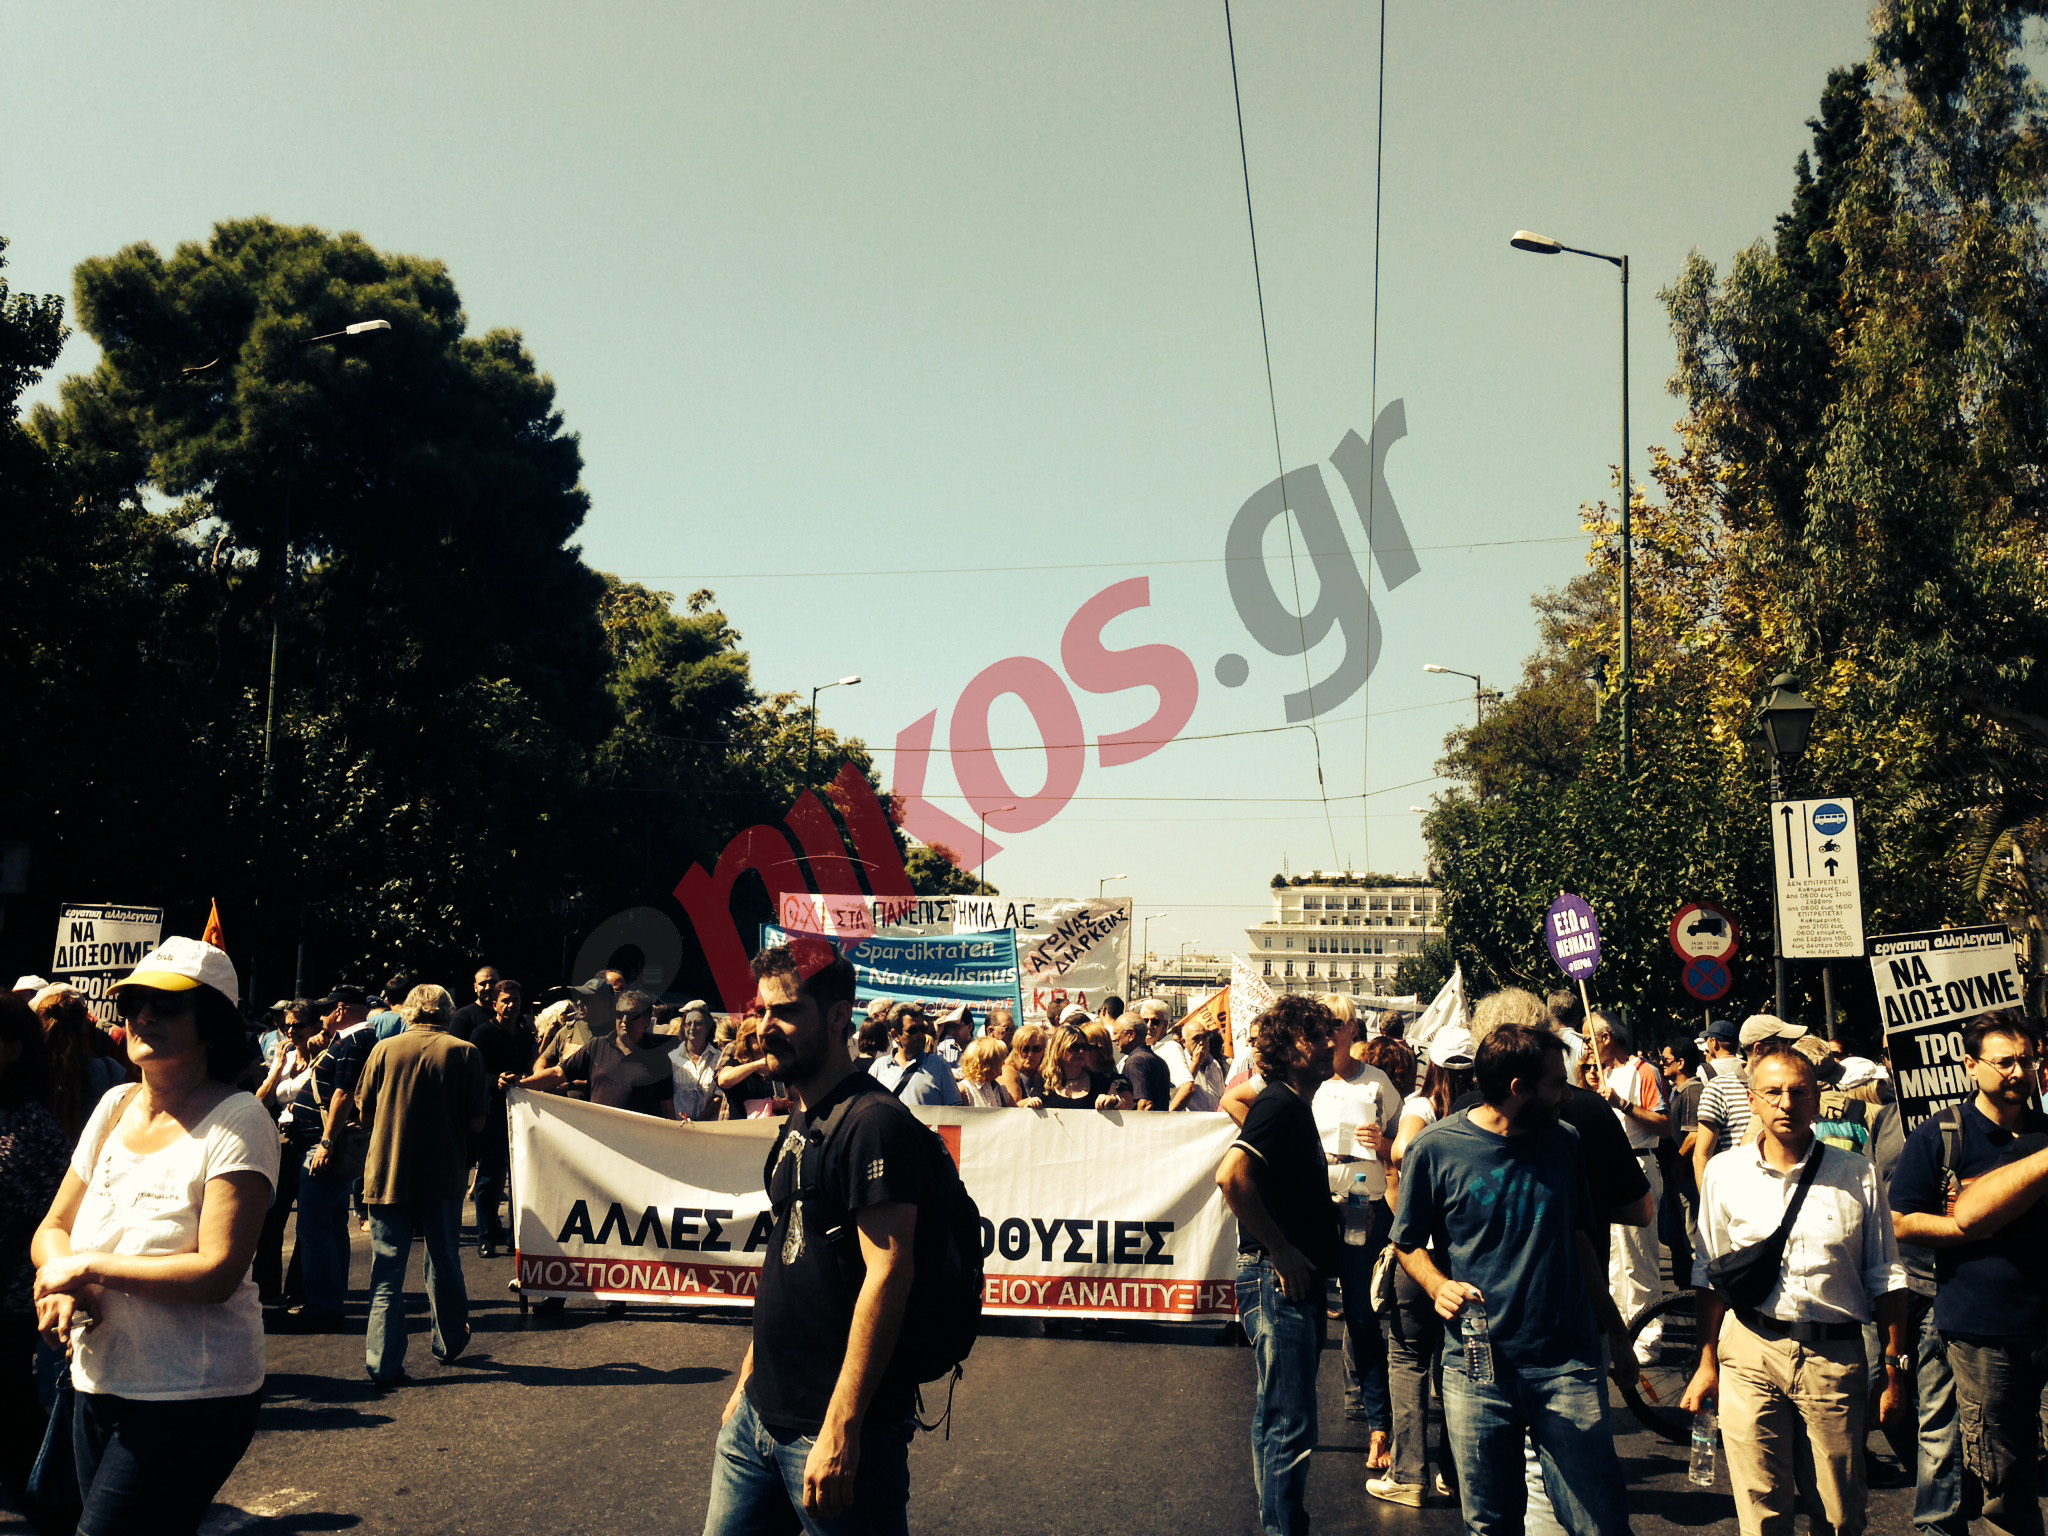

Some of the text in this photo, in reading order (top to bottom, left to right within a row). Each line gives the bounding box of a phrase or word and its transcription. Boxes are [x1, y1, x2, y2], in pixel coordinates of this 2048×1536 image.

[70, 921, 95, 943] ΝΑ
[836, 910, 866, 929] ΣΤΑ
[873, 900, 997, 929] ΠΑΝΕΠΙΣΤΗΜΙΑ
[56, 941, 154, 968] ΔΙΩΞΟΥΜΕ
[854, 940, 995, 963] Spardiktaten
[1055, 907, 1129, 976] ΔΙΑΡΚΕΙΑΣ
[867, 966, 1017, 986] Nationalismus
[1888, 954, 1933, 990] ΝΑ
[1883, 968, 2020, 1029] ΔΙΩΞΟΥΜΕ
[1914, 1029, 1967, 1065] ΤΡΟ
[1899, 1064, 1979, 1099] ΜΝΗΜ
[556, 1199, 734, 1252] ΑΛΛΕΣ
[521, 1259, 761, 1295] ΜΟΣΠΟΝΔΙΑ ΣΥΛ
[985, 1278, 1233, 1311] ΕΙΟΥ ΑΝΑΠΤΥΞΗΣ
